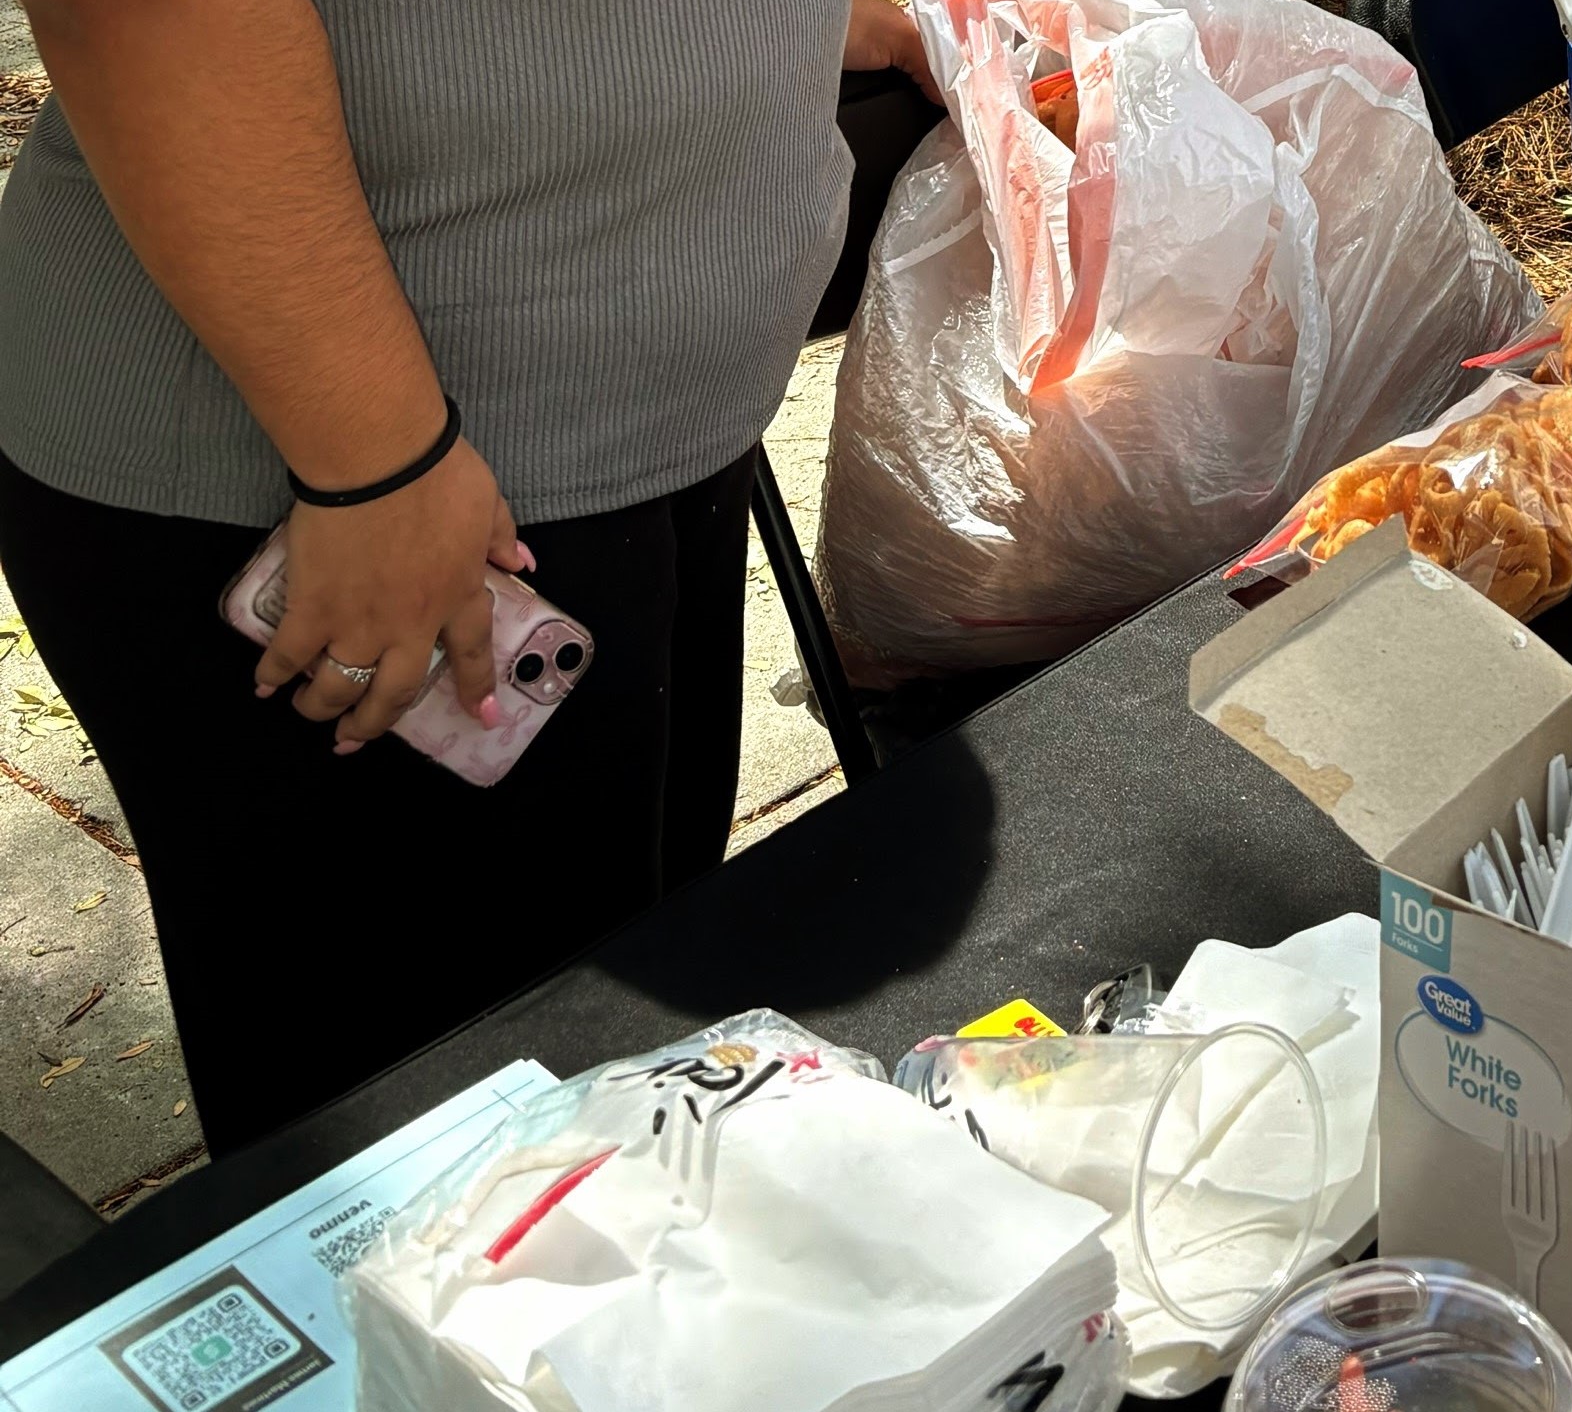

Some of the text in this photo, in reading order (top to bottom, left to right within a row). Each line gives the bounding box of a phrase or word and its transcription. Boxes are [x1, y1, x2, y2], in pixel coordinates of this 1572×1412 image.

[1390, 889, 1445, 946] 100
[1391, 932, 1419, 955] Forks
[1424, 979, 1472, 1017] Great
[1435, 999, 1472, 1027] Value
[1445, 1034, 1522, 1092] White
[1448, 1063, 1519, 1118] Forks
[308, 1197, 373, 1241] venmo
